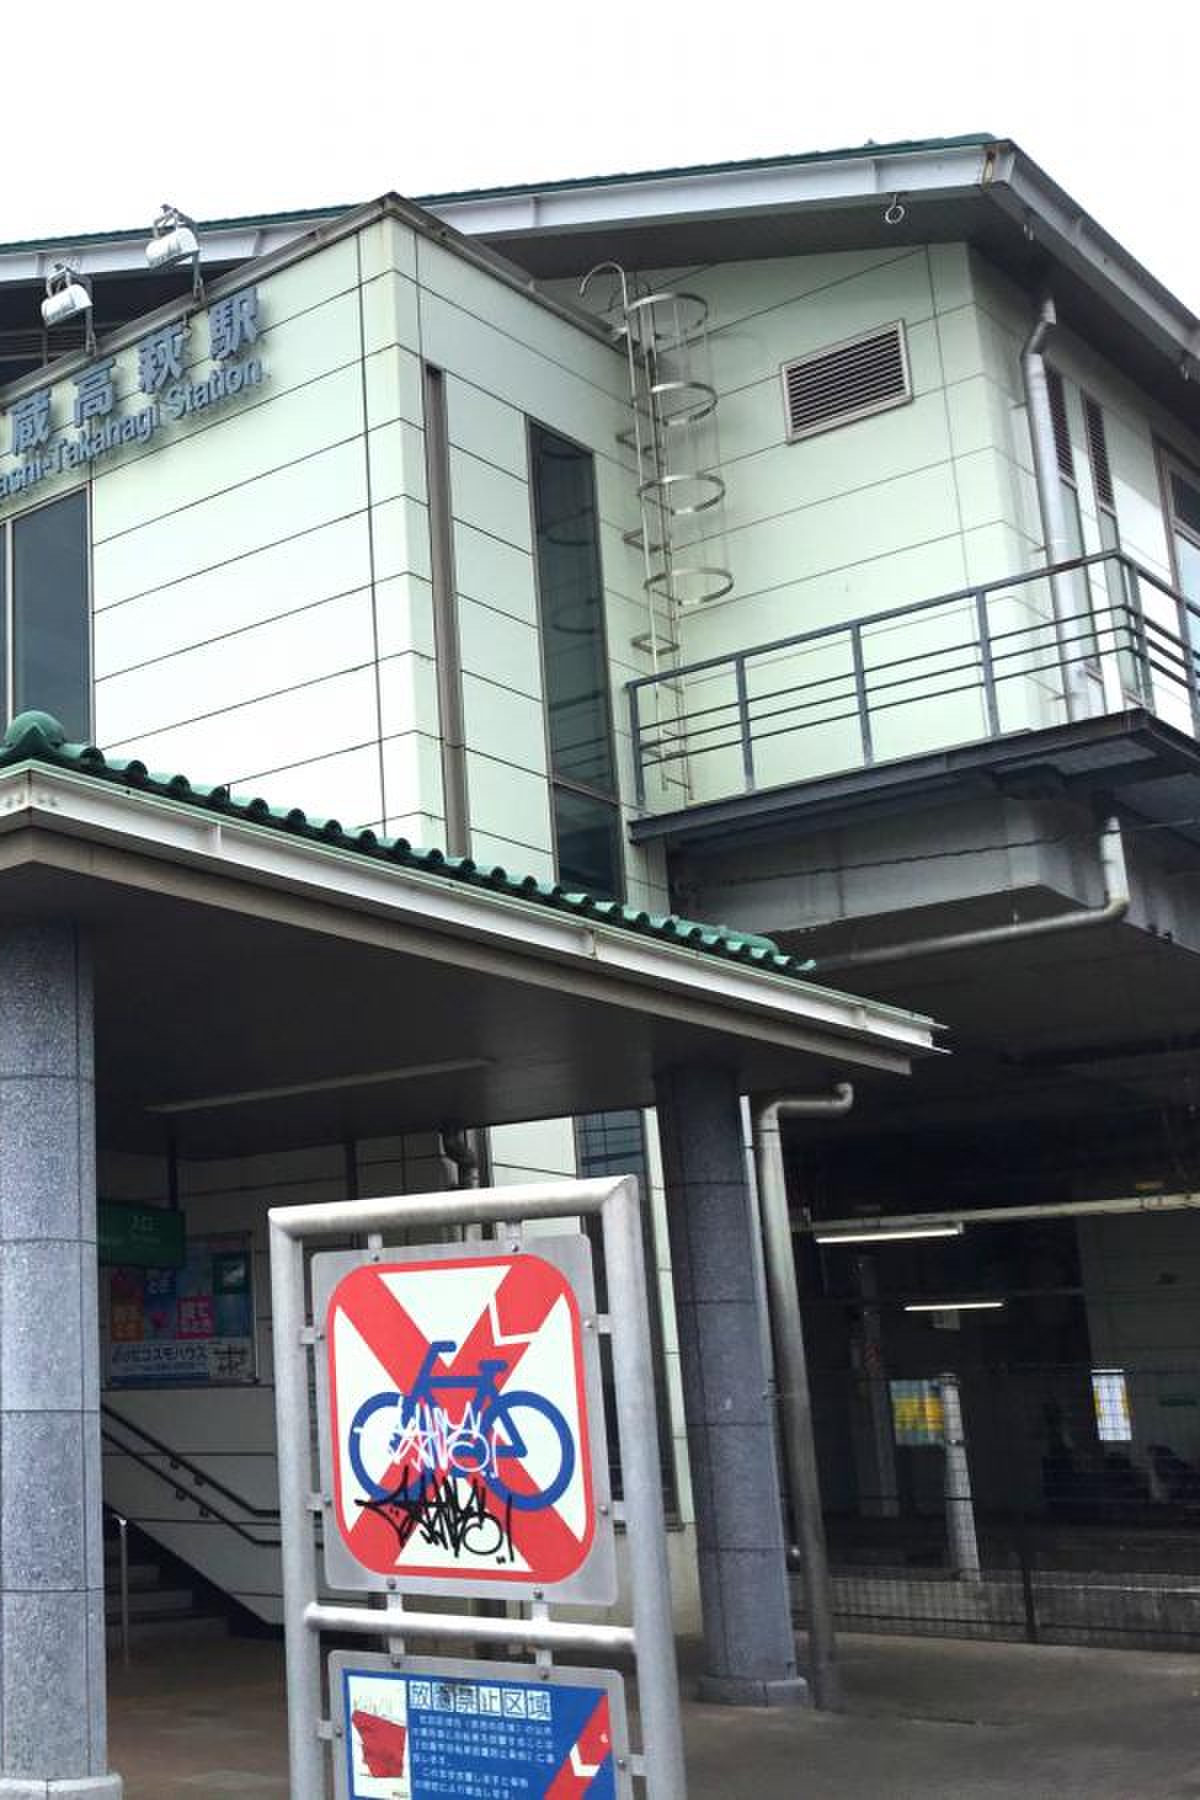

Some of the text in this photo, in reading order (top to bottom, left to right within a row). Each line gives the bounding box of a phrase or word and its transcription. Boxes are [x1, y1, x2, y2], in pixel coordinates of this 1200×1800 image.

[166, 357, 264, 419] Station
[410, 1682, 552, 1720] 放置禁止区域
